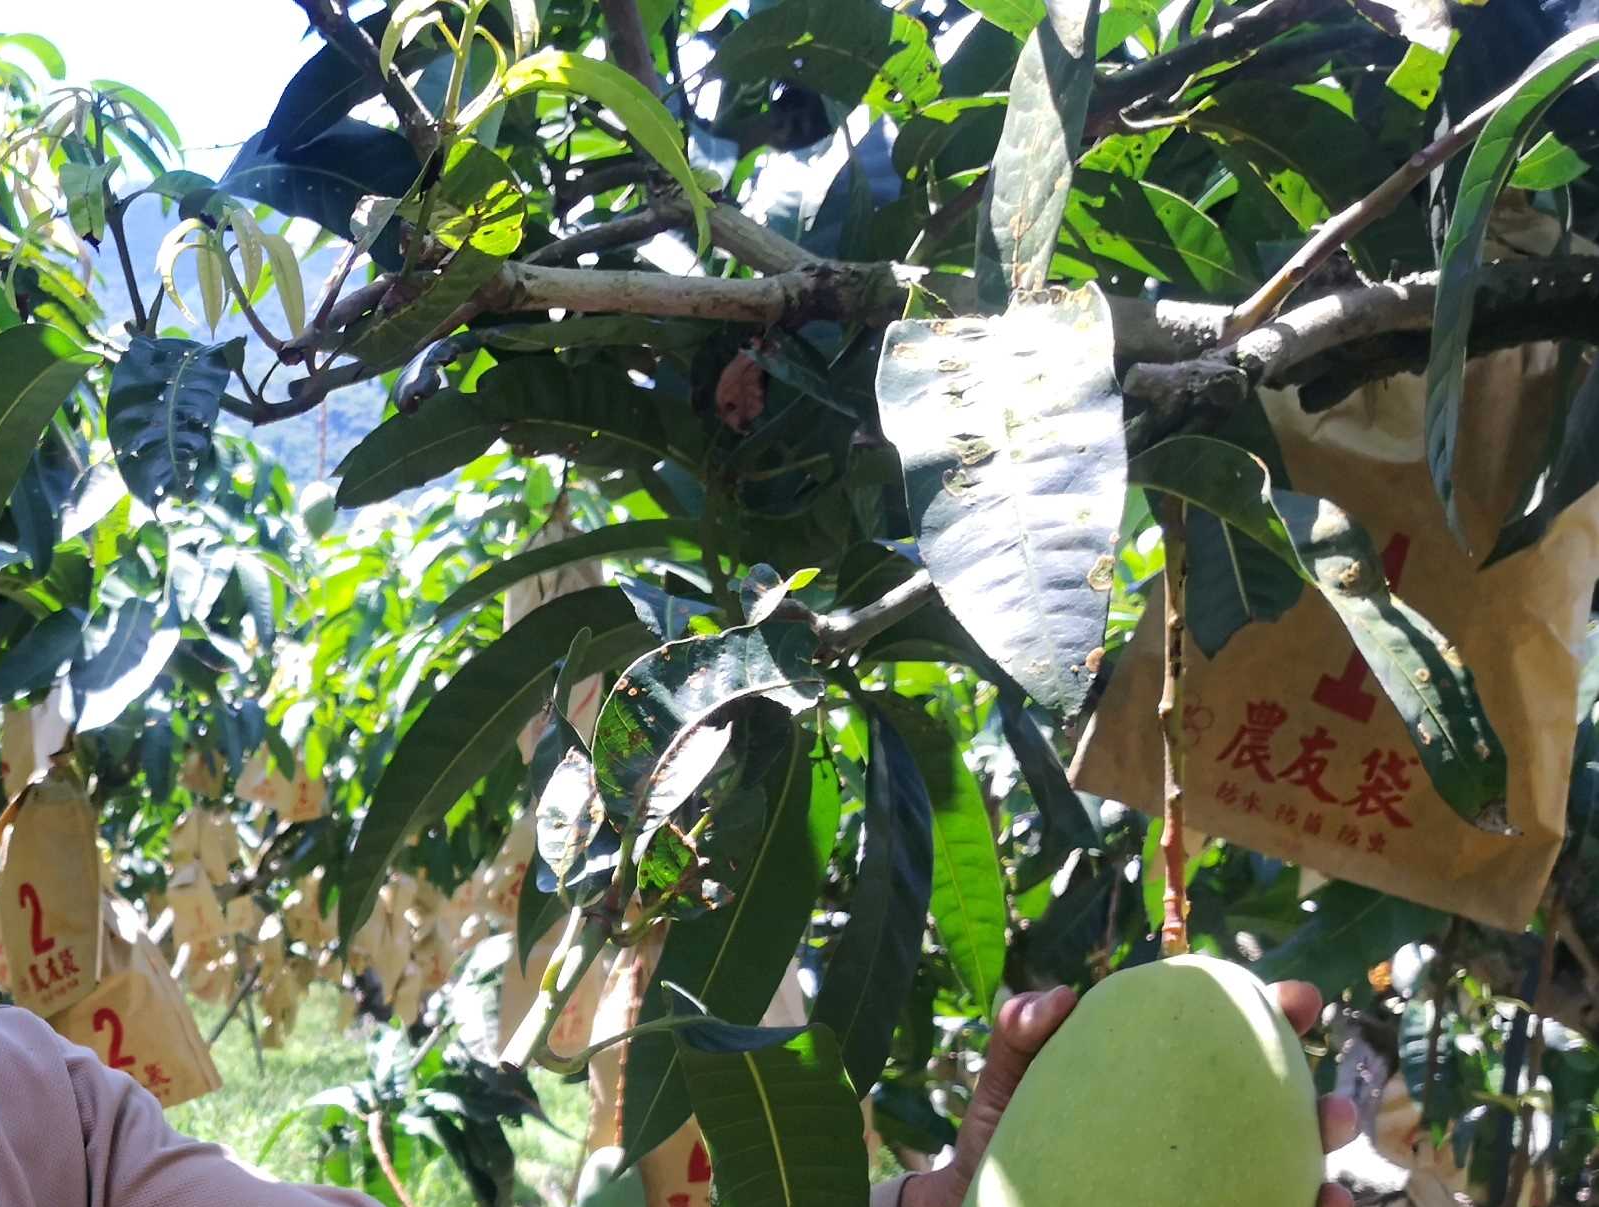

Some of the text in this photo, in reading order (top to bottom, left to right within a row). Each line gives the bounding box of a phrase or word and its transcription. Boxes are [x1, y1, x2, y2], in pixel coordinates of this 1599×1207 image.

[1215, 699, 1422, 831] 農友袋
[19, 881, 56, 956] 2
[93, 1007, 137, 1068] 2
